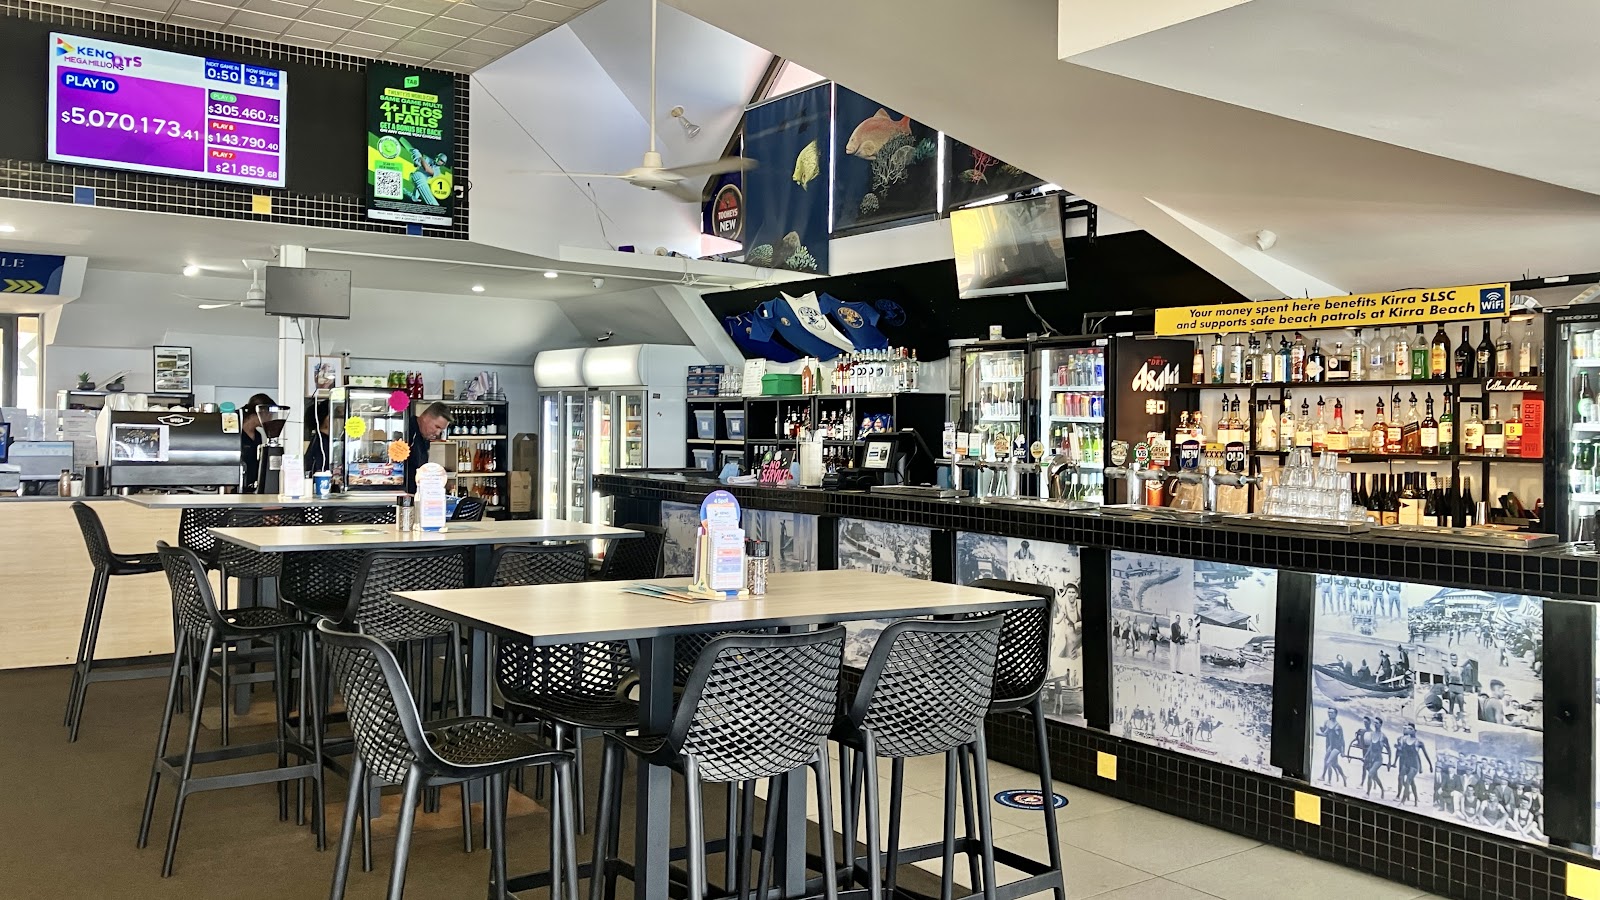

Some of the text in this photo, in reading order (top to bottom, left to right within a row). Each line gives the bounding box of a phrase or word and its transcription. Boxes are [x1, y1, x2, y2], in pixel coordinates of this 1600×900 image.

[77, 46, 114, 59] KENO
[64, 56, 125, 71] MEGA MILLIONS
[207, 68, 239, 81] 0:50
[246, 67, 277, 77] NOW SELLING
[66, 74, 116, 91] PLAY 10
[249, 76, 274, 88] 914
[380, 95, 443, 109] SAME GAME MULTI
[380, 101, 443, 119] 4+ LEGS
[61, 107, 199, 141] $5,070,173.41
[212, 122, 228, 130] PLAY
[380, 121, 391, 129] GET
[384, 112, 438, 128] 1 FAILS
[438, 182, 443, 190] 1
[719, 218, 737, 232] NEW
[1190, 290, 1456, 318] Your money spent here benefits Kirra SLSC
[1481, 299, 1504, 311] WiFi
[1176, 302, 1475, 330] and supports safe beach patrols at Kirra Beach
[1132, 361, 1180, 392] Asahi
[1524, 403, 1535, 428] PIPER
[1181, 449, 1198, 459] NEW
[1226, 451, 1244, 462] OLD
